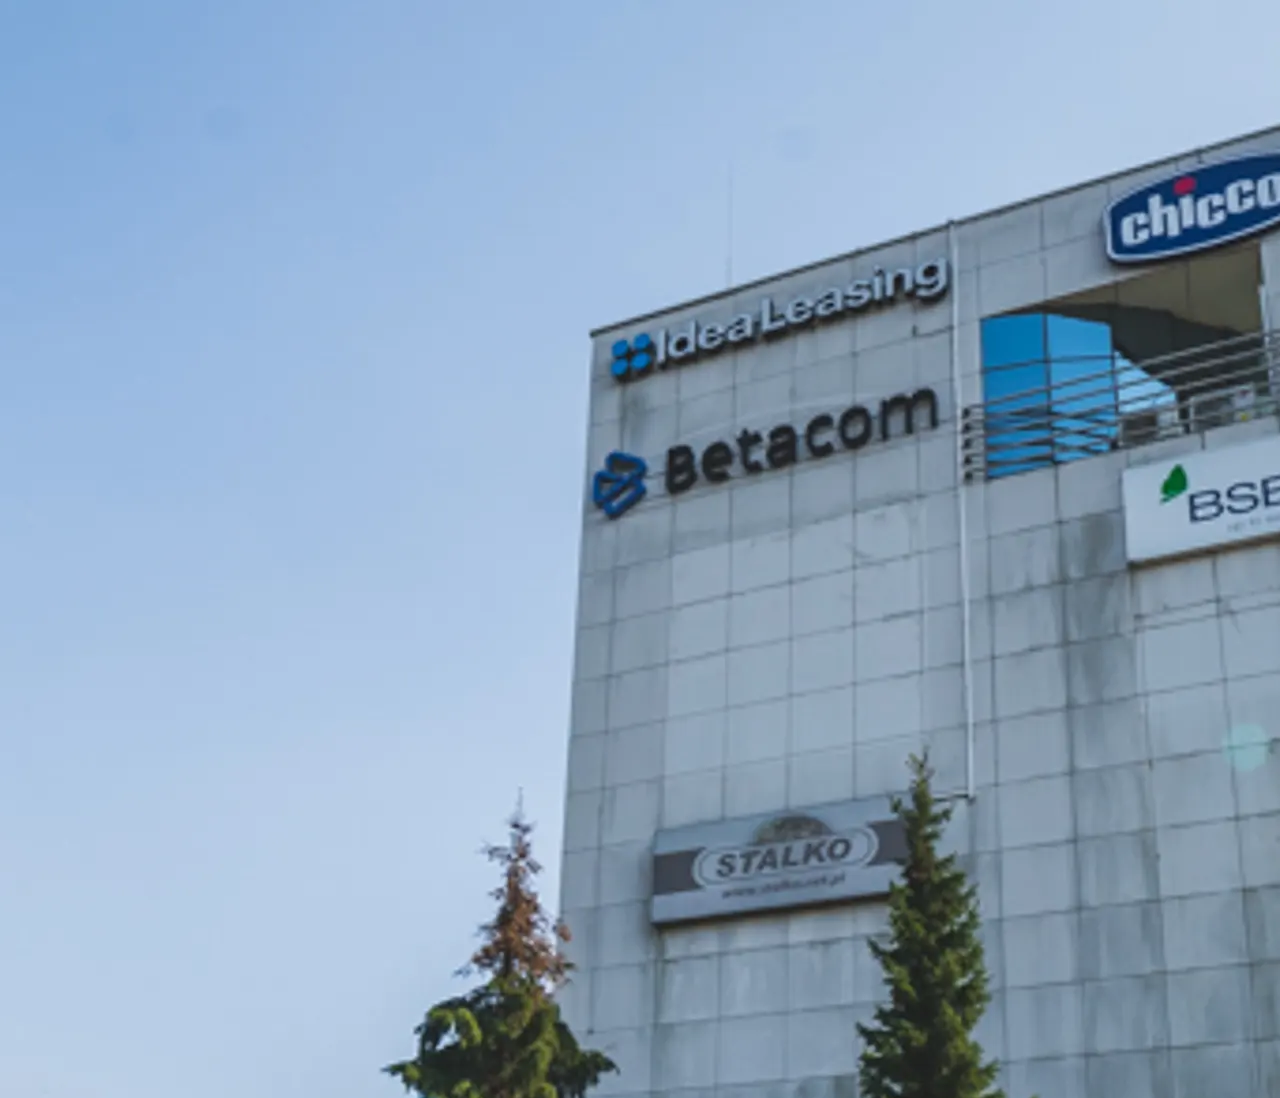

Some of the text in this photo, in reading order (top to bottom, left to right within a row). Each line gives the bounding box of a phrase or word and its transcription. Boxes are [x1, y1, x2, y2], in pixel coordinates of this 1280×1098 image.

[656, 256, 950, 364] Idea Leasing
[665, 386, 938, 494] Betacom
[716, 836, 851, 878] STALKO
